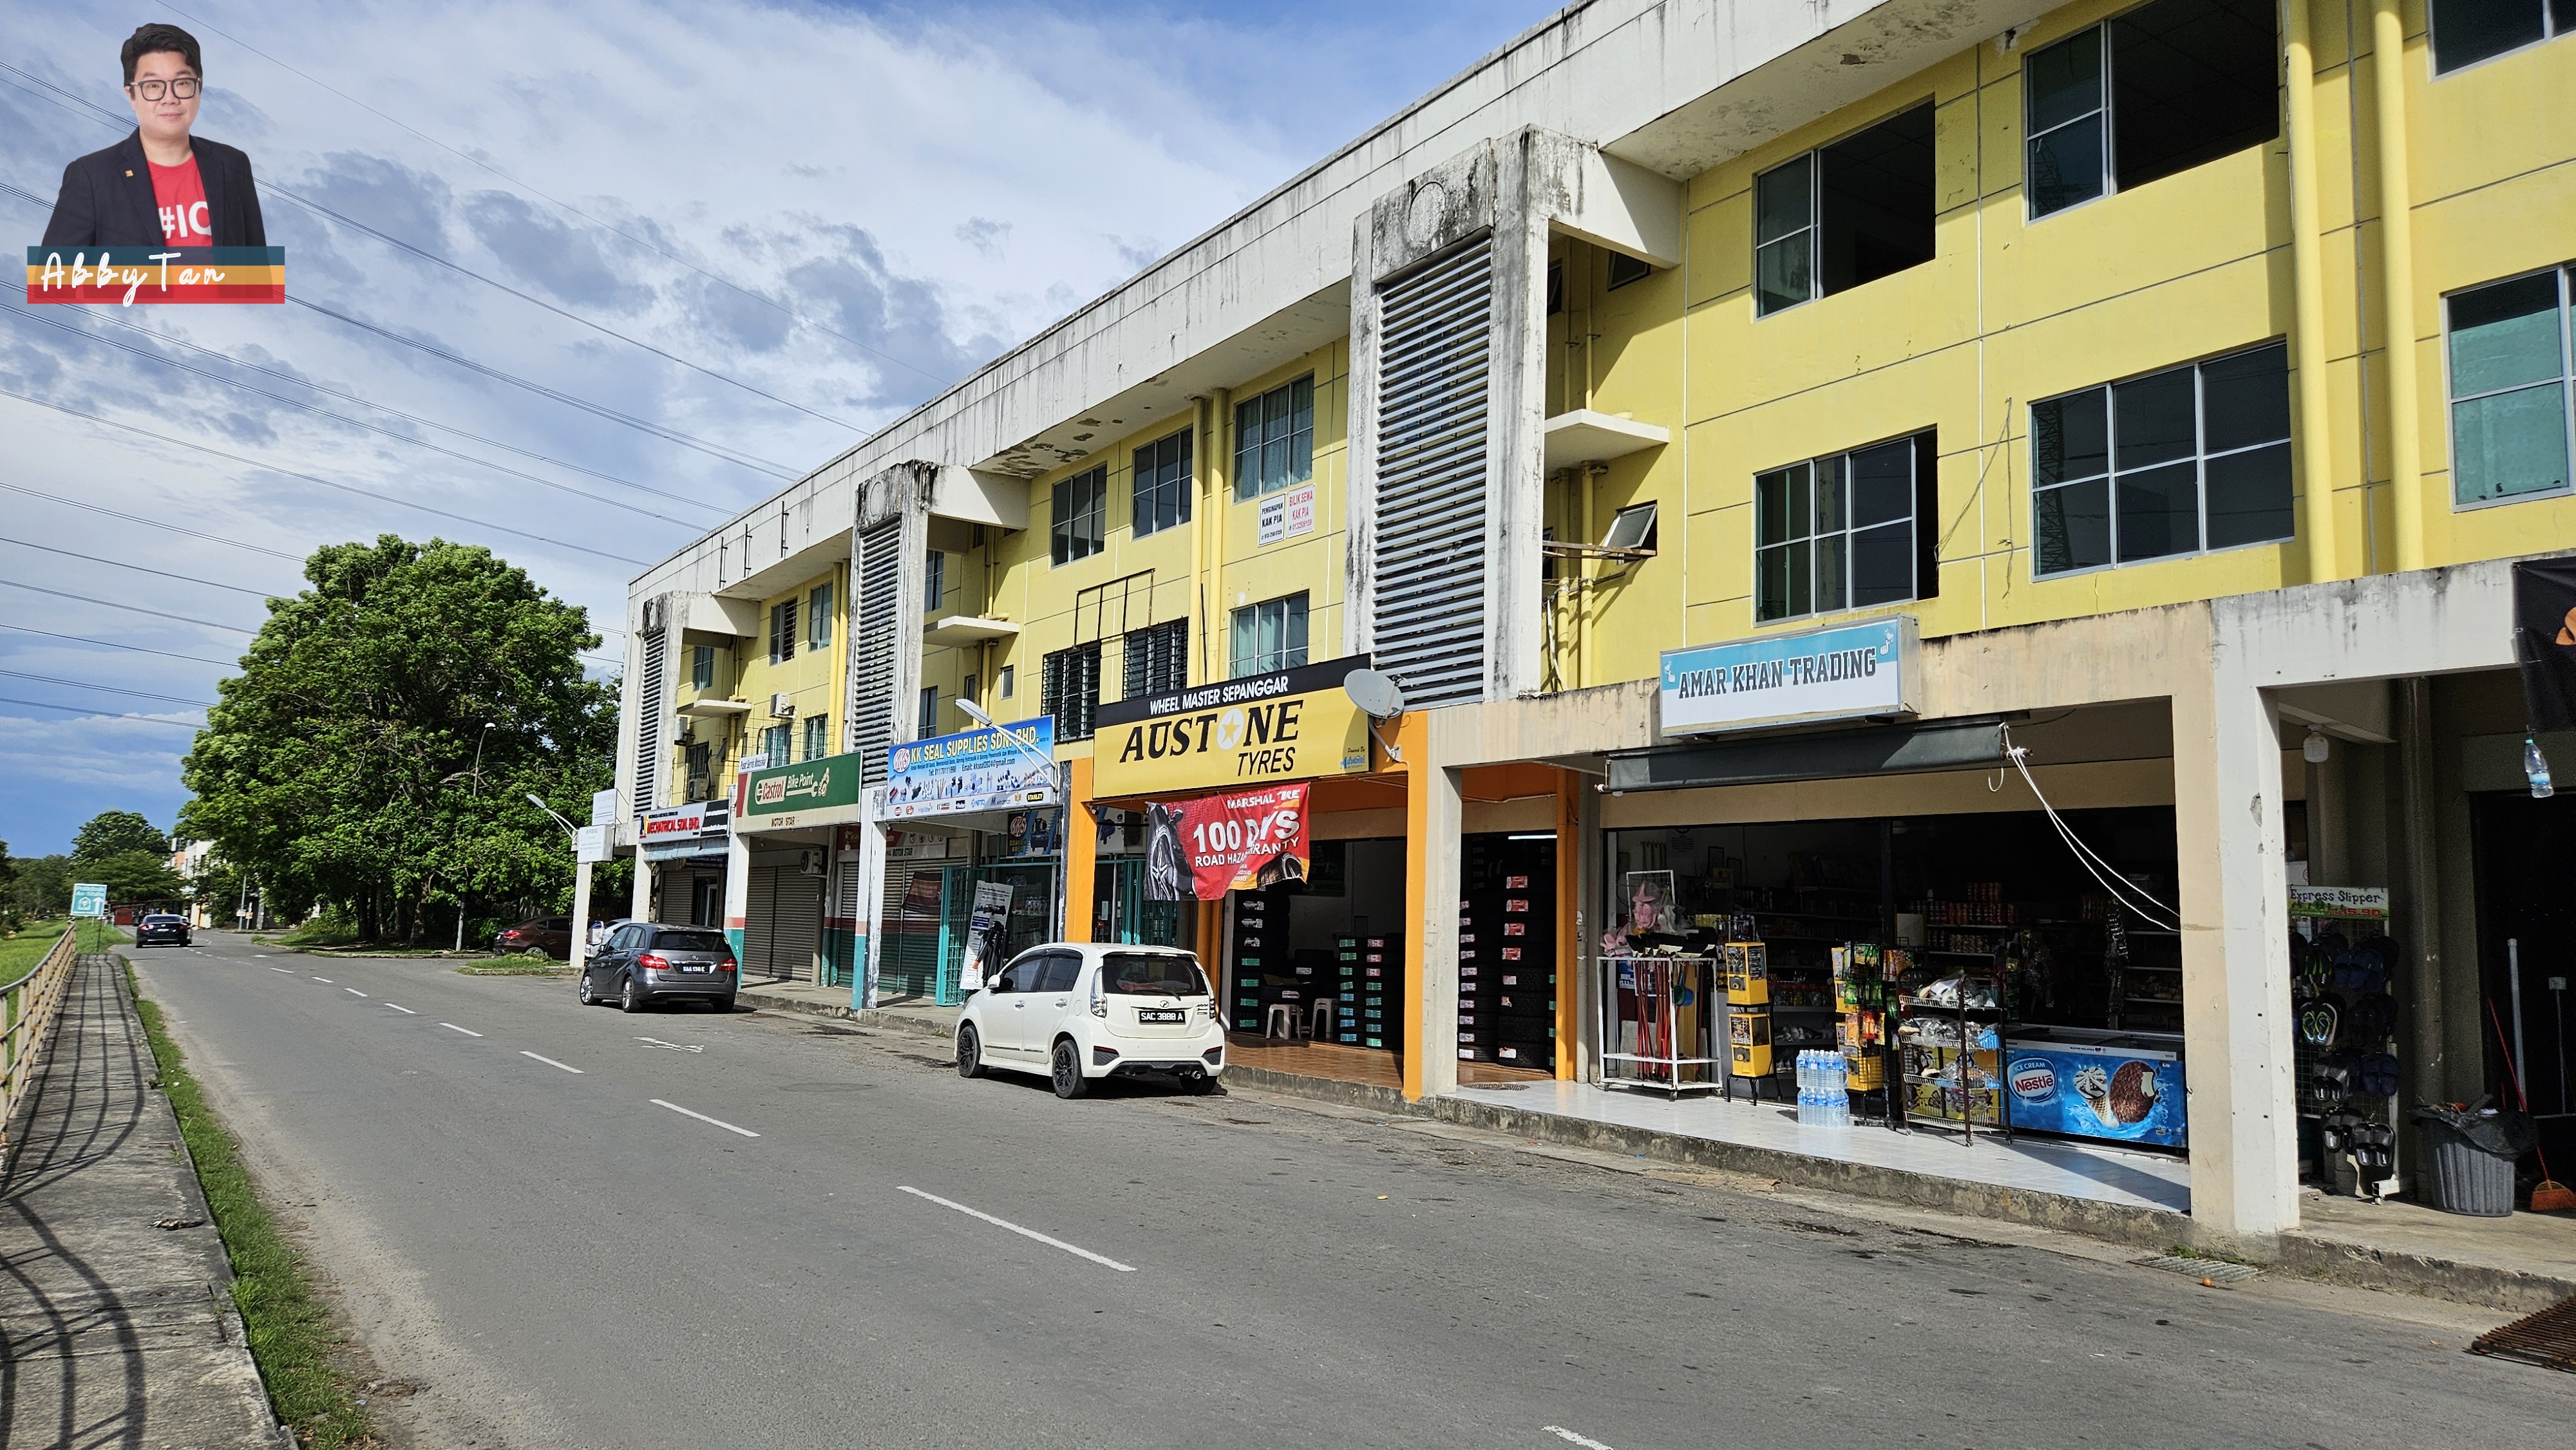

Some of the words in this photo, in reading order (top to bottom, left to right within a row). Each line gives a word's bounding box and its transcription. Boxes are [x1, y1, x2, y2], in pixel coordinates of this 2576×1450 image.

[1301, 491, 1313, 503] SEWA
[1262, 516, 1273, 528] KAK
[1273, 514, 1282, 524] PIA
[1678, 668, 1727, 699] AMAR
[1731, 659, 1783, 693] KHAN
[1789, 646, 1877, 686] TRADING
[1150, 698, 1180, 715] WHEEL
[1182, 688, 1220, 709] MASTER
[1222, 675, 1289, 702] SEPANGGAR
[911, 746, 922, 764] KK
[923, 742, 945, 762] SEAL
[947, 733, 989, 758] SUPPLIES
[1237, 746, 1296, 777] TYRES
[762, 780, 784, 800] Castrol
[787, 774, 799, 789] Bike
[799, 771, 814, 787] Point
[1227, 793, 1275, 809] MARSHAL
[1193, 820, 1240, 853] 100
[1195, 854, 1225, 867] ROAD
[2290, 889, 2334, 903] Express
[2338, 890, 2382, 905] Slipper
[1141, 1012, 1156, 1021] SAC
[1177, 1012, 1184, 1021] A
[2024, 1061, 2046, 1069] CREAM
